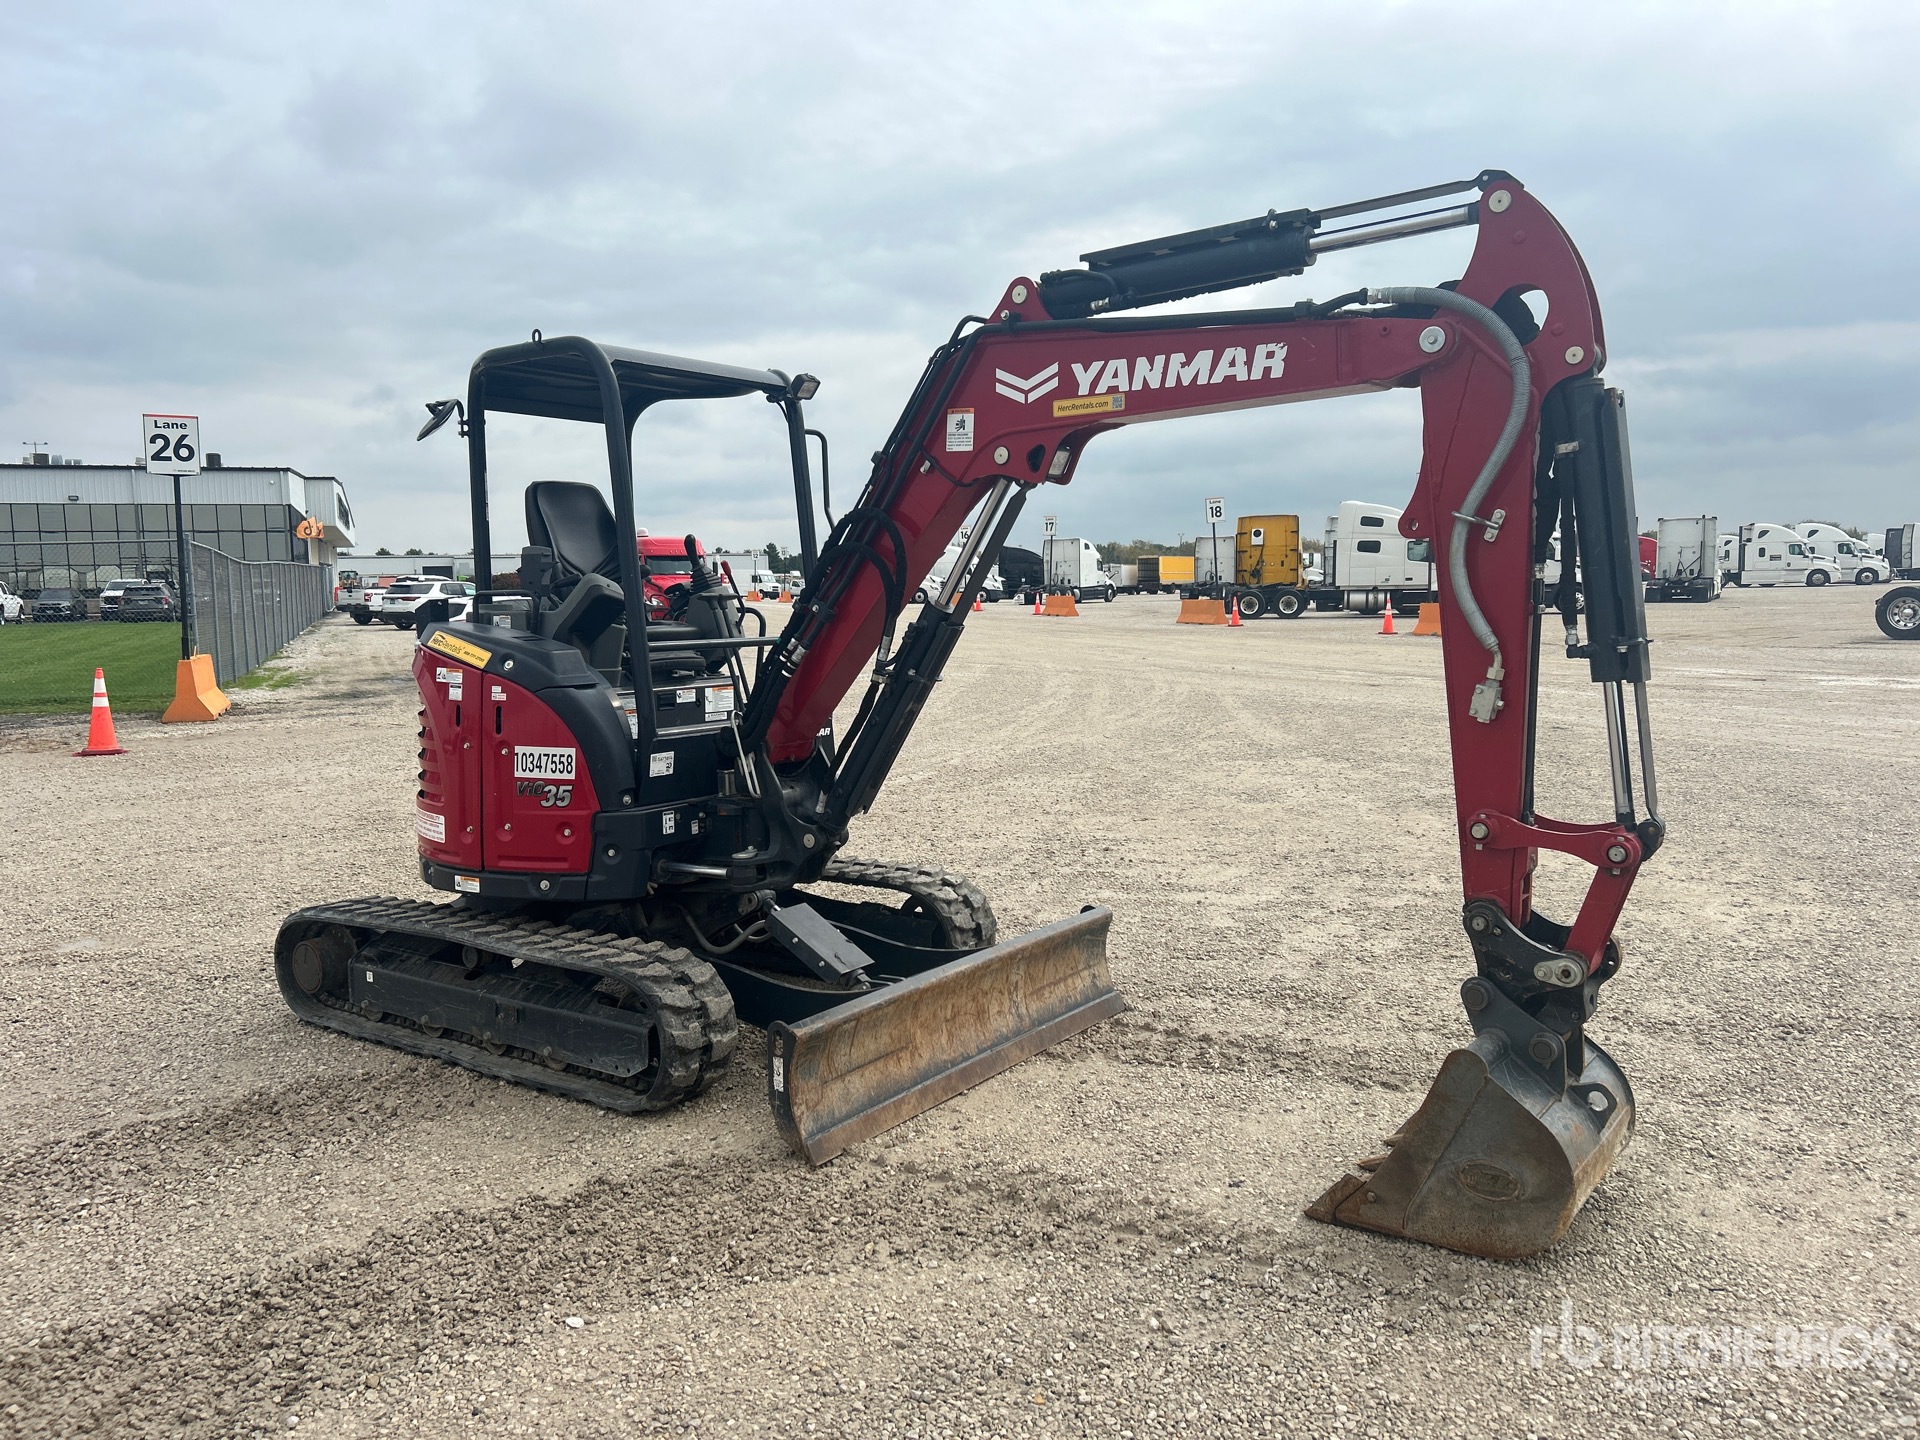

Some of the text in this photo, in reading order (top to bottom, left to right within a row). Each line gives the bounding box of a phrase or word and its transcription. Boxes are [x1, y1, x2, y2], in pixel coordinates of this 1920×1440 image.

[1071, 342, 1288, 396] YANMAR
[1057, 401, 1109, 412] HercRentals.com
[154, 420, 188, 430] Lane
[149, 433, 195, 462] 26
[1209, 505, 1223, 518] 18
[1045, 522, 1055, 532] 17
[960, 531, 969, 540] 16
[515, 752, 573, 774] 10347558
